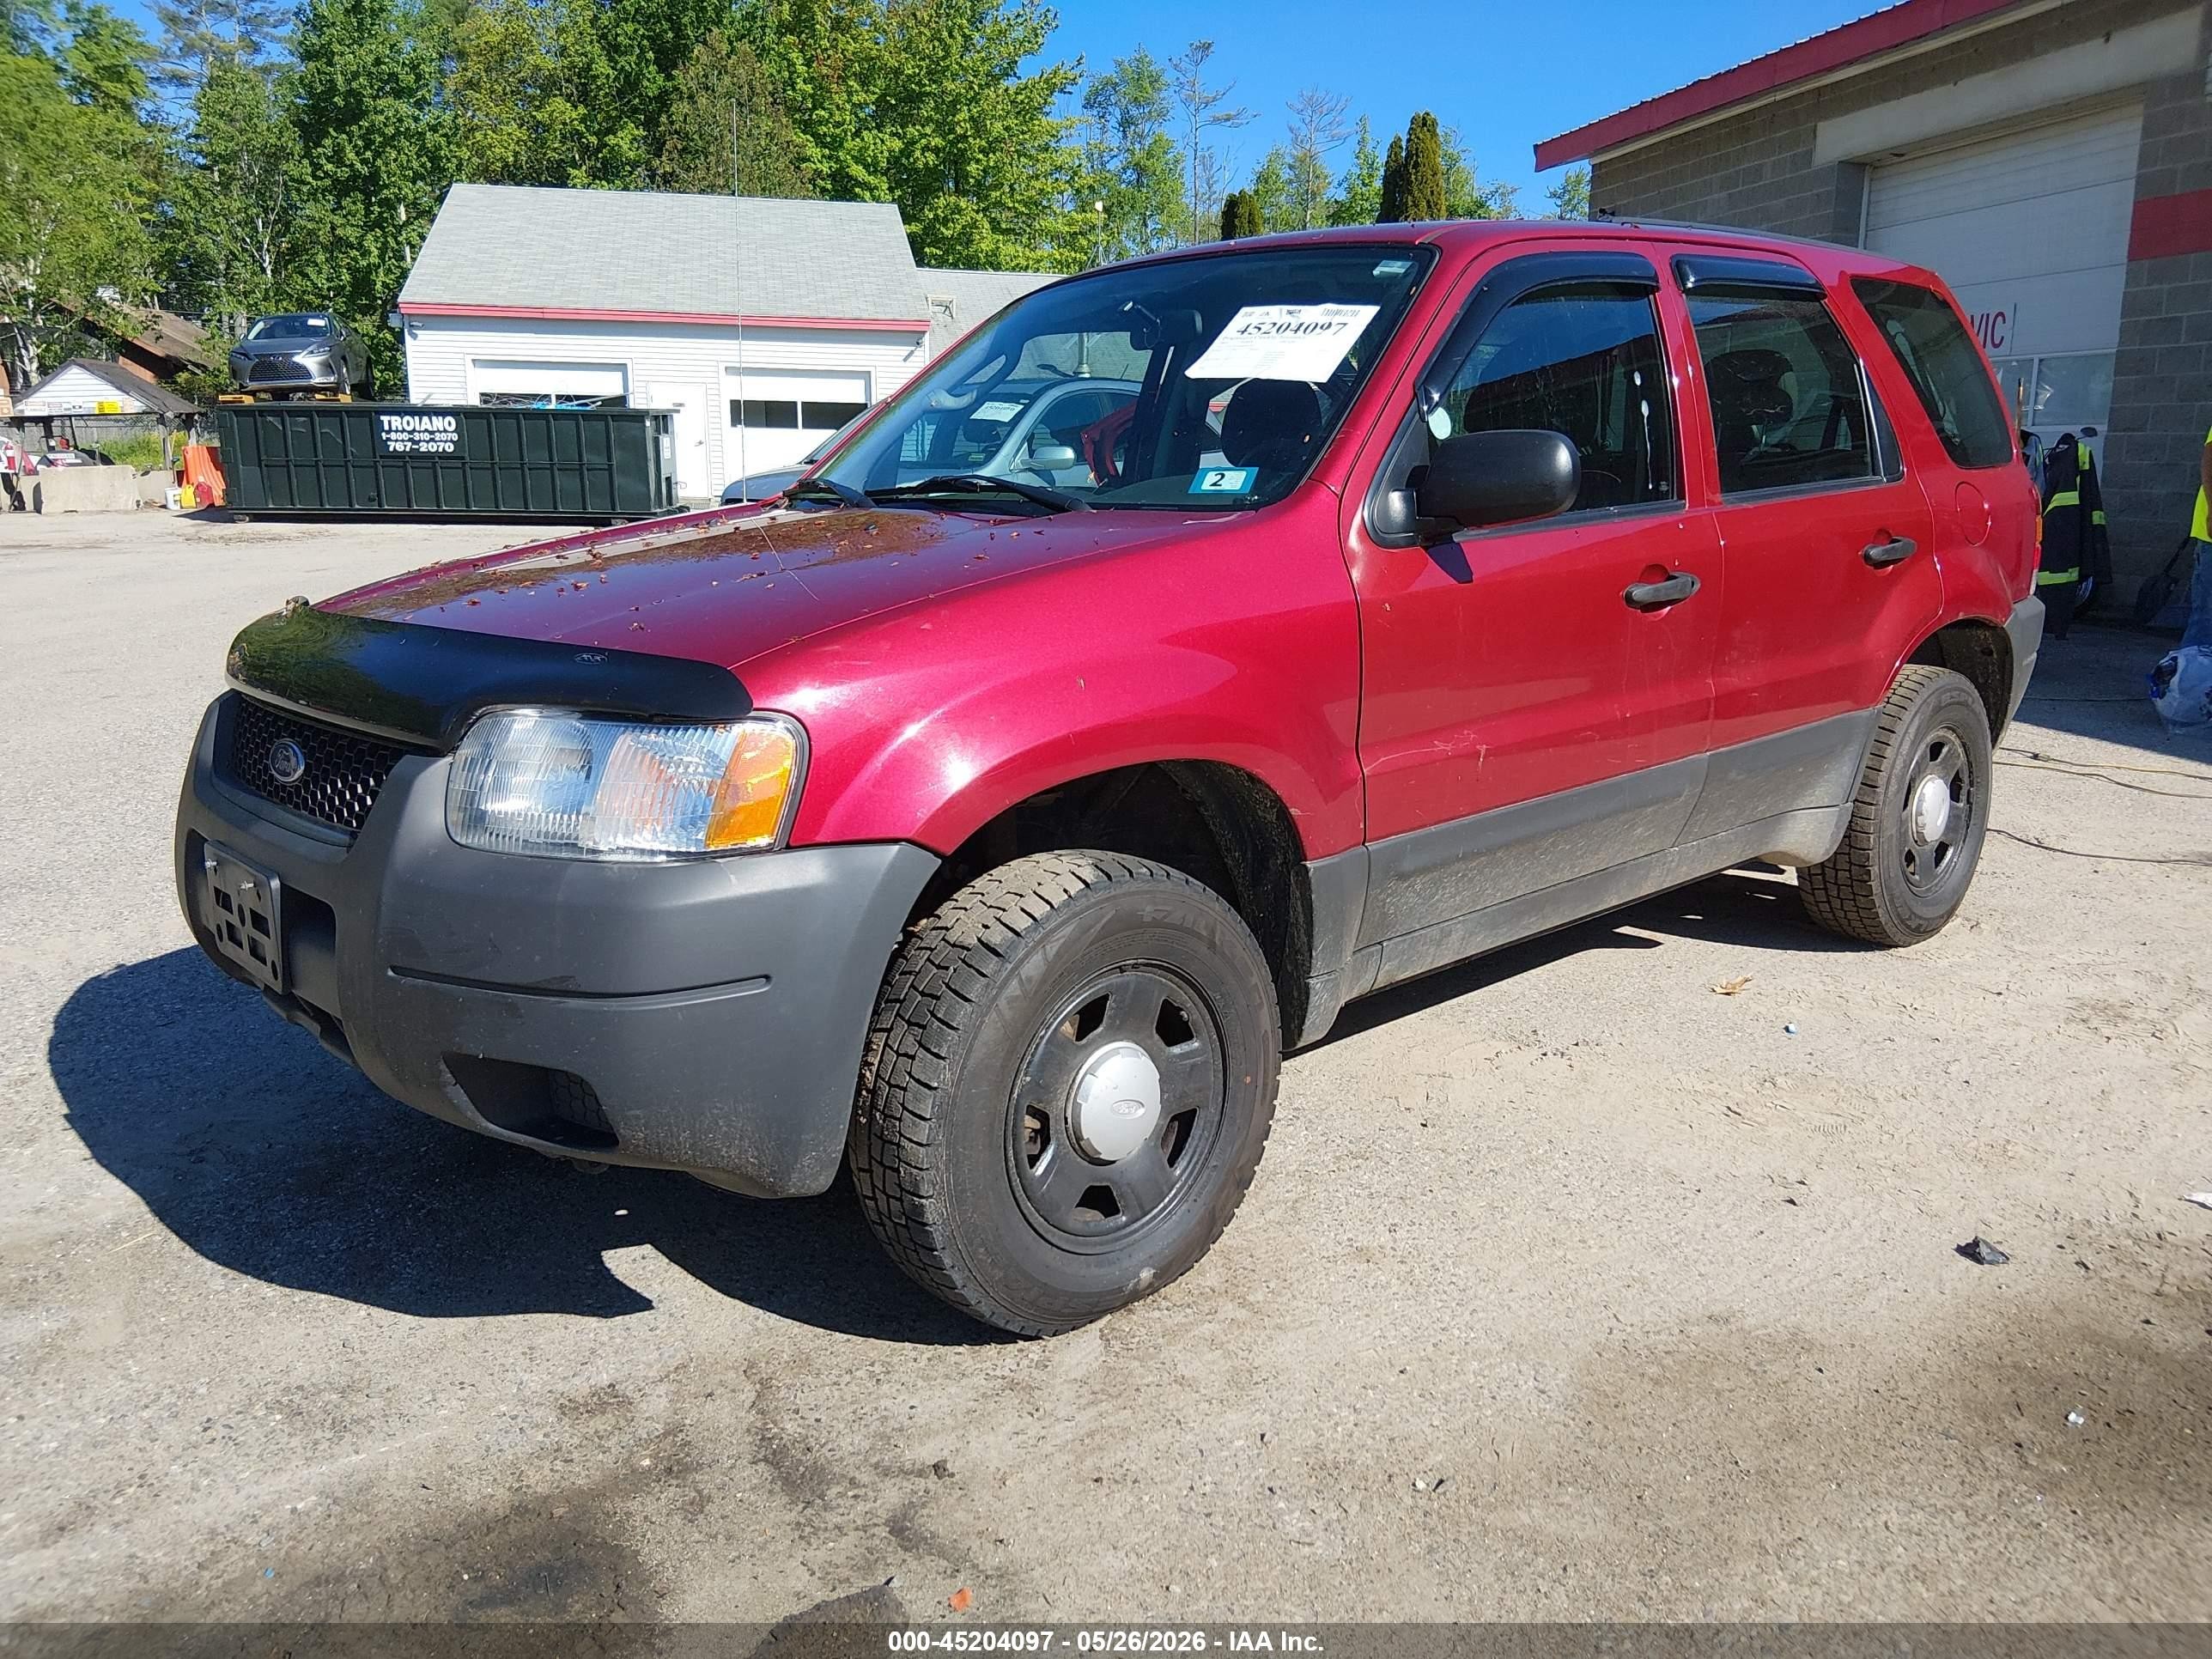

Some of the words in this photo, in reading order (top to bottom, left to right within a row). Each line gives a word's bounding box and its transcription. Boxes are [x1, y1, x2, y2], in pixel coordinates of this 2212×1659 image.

[1237, 321, 1349, 336] 45204097
[380, 415, 457, 431] TROIANO
[380, 432, 459, 441] 1-800-310-2070
[386, 441, 454, 453] 767-2070
[1208, 471, 1226, 487] 2
